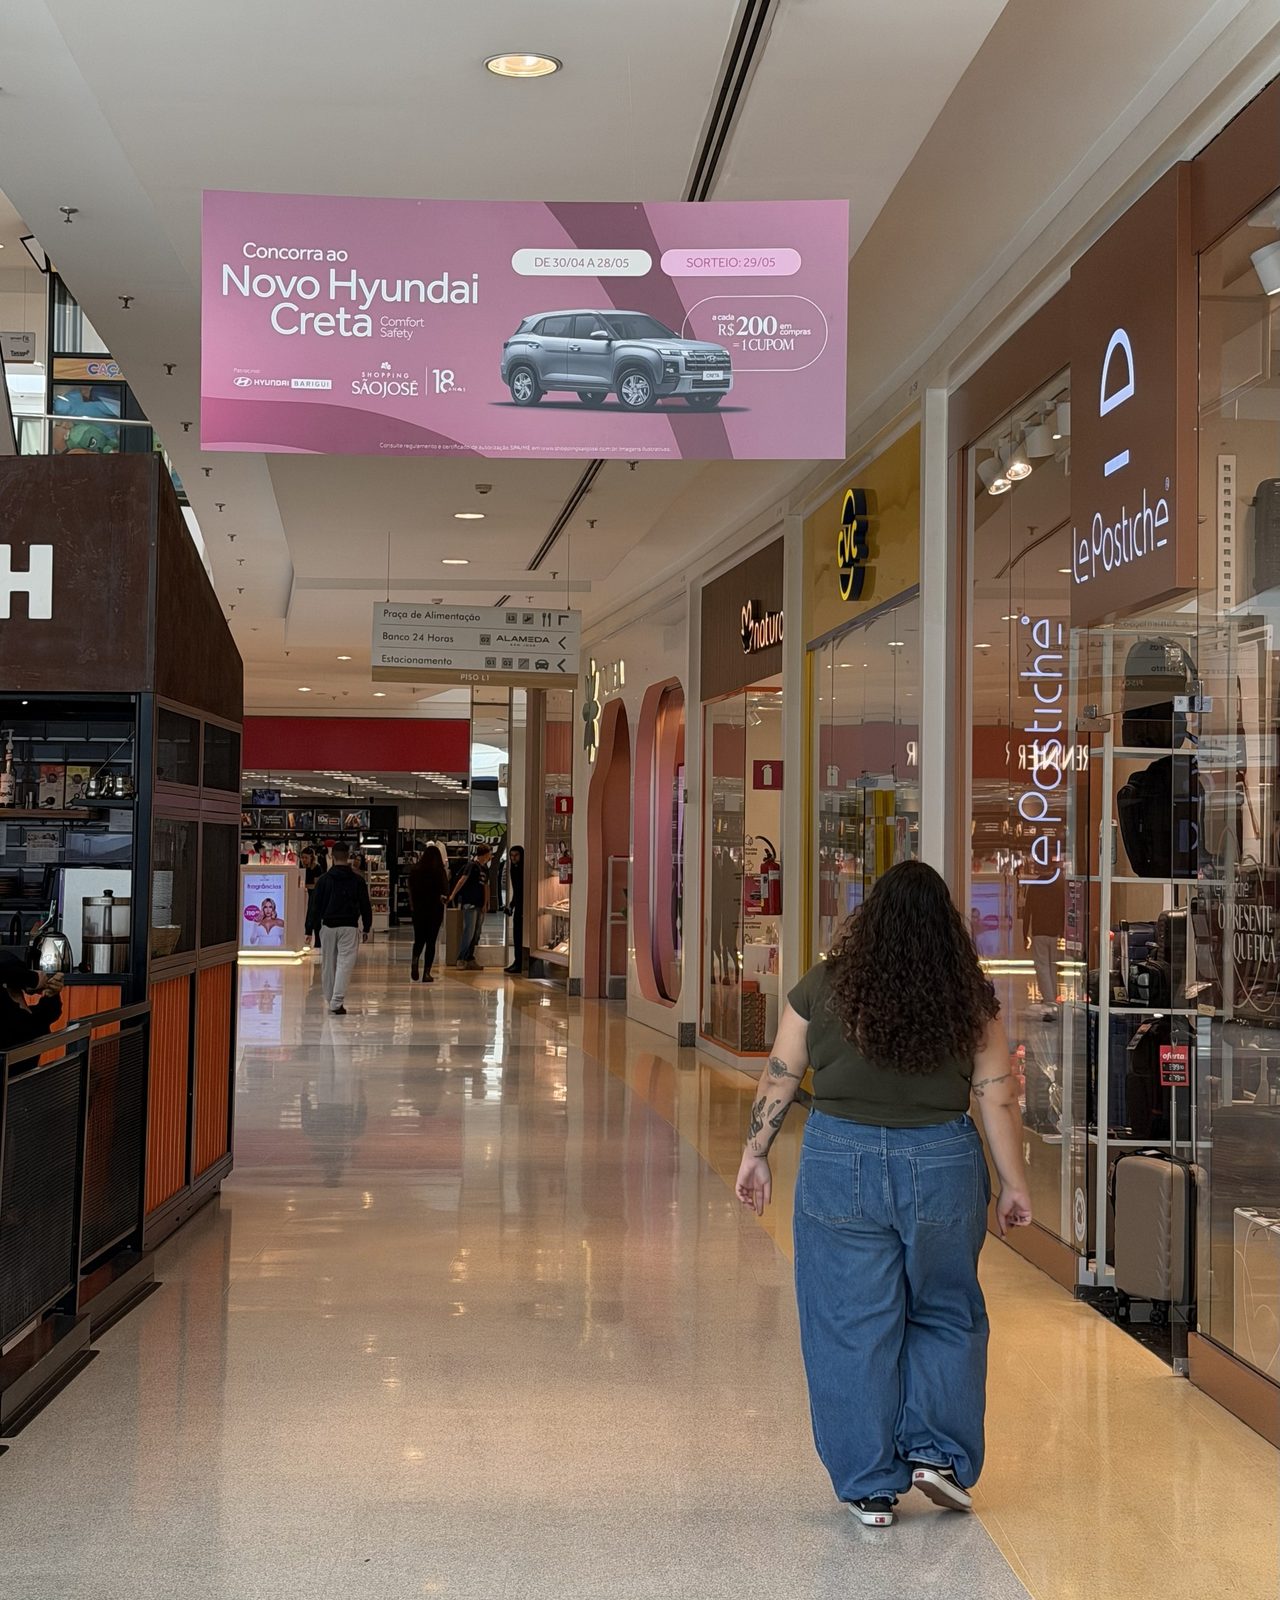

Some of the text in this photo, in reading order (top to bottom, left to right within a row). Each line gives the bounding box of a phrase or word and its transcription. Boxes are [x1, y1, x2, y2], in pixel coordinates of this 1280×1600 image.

[243, 242, 348, 261] Concorra ao
[534, 257, 630, 268] DE 30/04 A 28/05
[686, 256, 776, 268] SORTEIO: 29/05
[222, 263, 478, 310] Novo Hyundai
[271, 302, 373, 337] Creta
[380, 316, 424, 327] Comfort
[718, 313, 735, 321] cada
[718, 323, 735, 336] R$
[736, 315, 778, 336] 200
[380, 327, 413, 340] Safety
[780, 328, 811, 337] compras
[748, 338, 794, 351] CUPOM
[361, 371, 410, 379] SHOPPING
[432, 369, 455, 393] 18
[253, 379, 330, 388] HYUNDAI BARIGUI
[383, 609, 408, 619] Praça
[410, 610, 422, 619] de
[424, 611, 481, 622] Alimentação
[382, 632, 410, 641] Banco
[412, 633, 424, 641] 24
[427, 634, 454, 643] Horas
[496, 635, 550, 643] ALAMEDA
[381, 655, 452, 665] Estacionamento
[460, 673, 479, 681] PISO
[1233, 932, 1276, 965] QUE FICA
